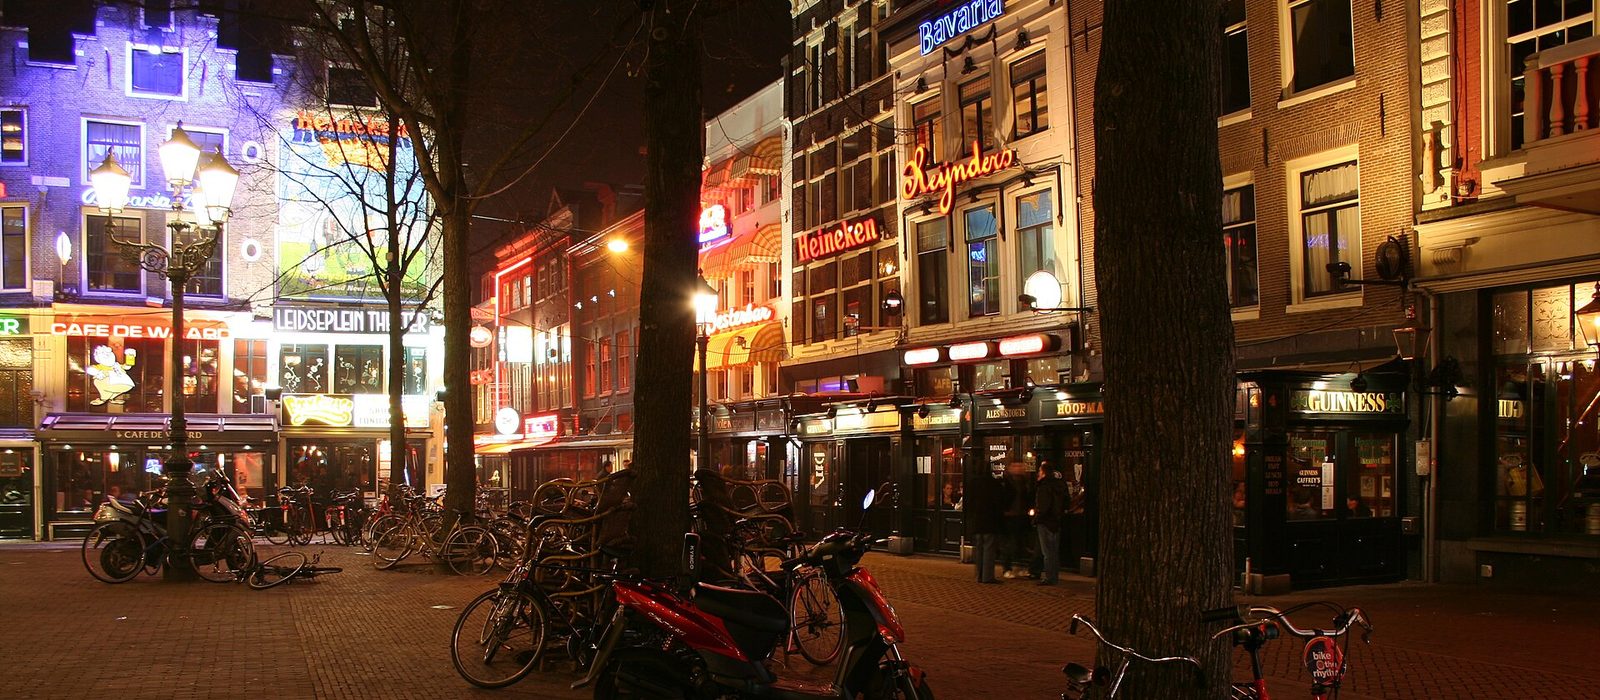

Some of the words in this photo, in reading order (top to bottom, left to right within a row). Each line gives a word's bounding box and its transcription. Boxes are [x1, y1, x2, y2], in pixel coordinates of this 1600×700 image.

[919, 0, 1004, 57] Bavaria
[797, 217, 878, 262] Heineken
[51, 322, 109, 337] CAFE
[113, 324, 143, 338] DE
[276, 309, 365, 333] LEIDSEPLEIN
[1308, 391, 1386, 413] GUINNESS
[986, 409, 1000, 419] ALES
[124, 431, 147, 439] CAFE
[151, 431, 163, 439] DE
[1312, 651, 1331, 661] bike
